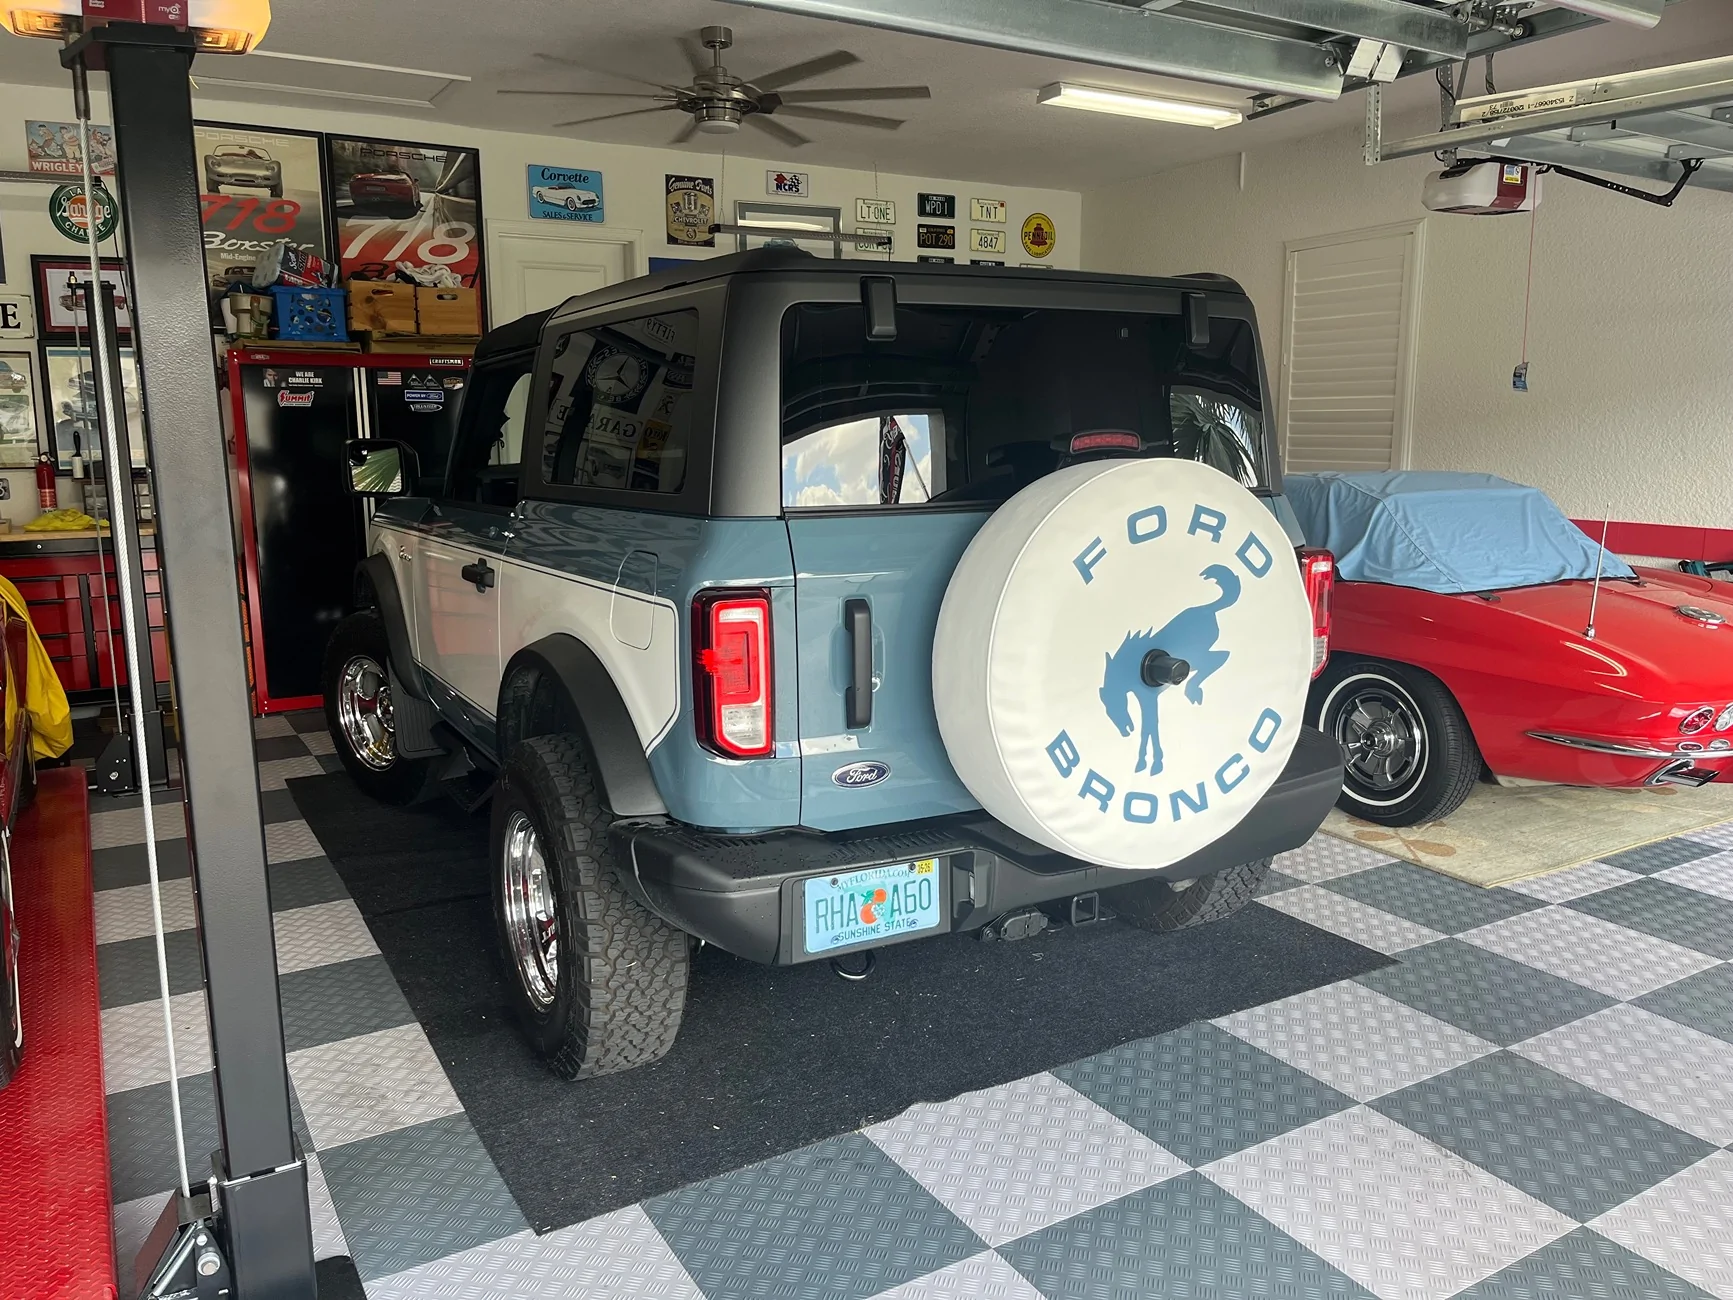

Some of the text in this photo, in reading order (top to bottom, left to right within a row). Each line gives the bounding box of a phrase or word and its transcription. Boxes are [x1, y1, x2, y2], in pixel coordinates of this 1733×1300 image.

[195, 131, 290, 147] PORSCHE
[360, 148, 448, 163] PORSCHE
[541, 168, 589, 184] Corvette
[669, 177, 713, 195] Genuine Parts
[775, 182, 800, 193] NCRS
[200, 194, 301, 234] 718
[543, 211, 562, 219] SALES
[566, 212, 593, 221] SERVICE
[674, 216, 708, 224] CHEVROLET
[979, 205, 998, 219] TNT
[342, 215, 476, 265] 718
[920, 233, 953, 246] POT 290
[978, 236, 999, 249] 4847
[1024, 231, 1053, 241] PENNZOIL
[220, 252, 257, 262] Mid-Engine
[1072, 503, 1274, 586] FORD
[1044, 707, 1283, 825] BRONCO
[847, 767, 878, 784] Ford
[815, 877, 932, 934] RHA A60
[838, 917, 912, 942] SUNSHINE STATE
